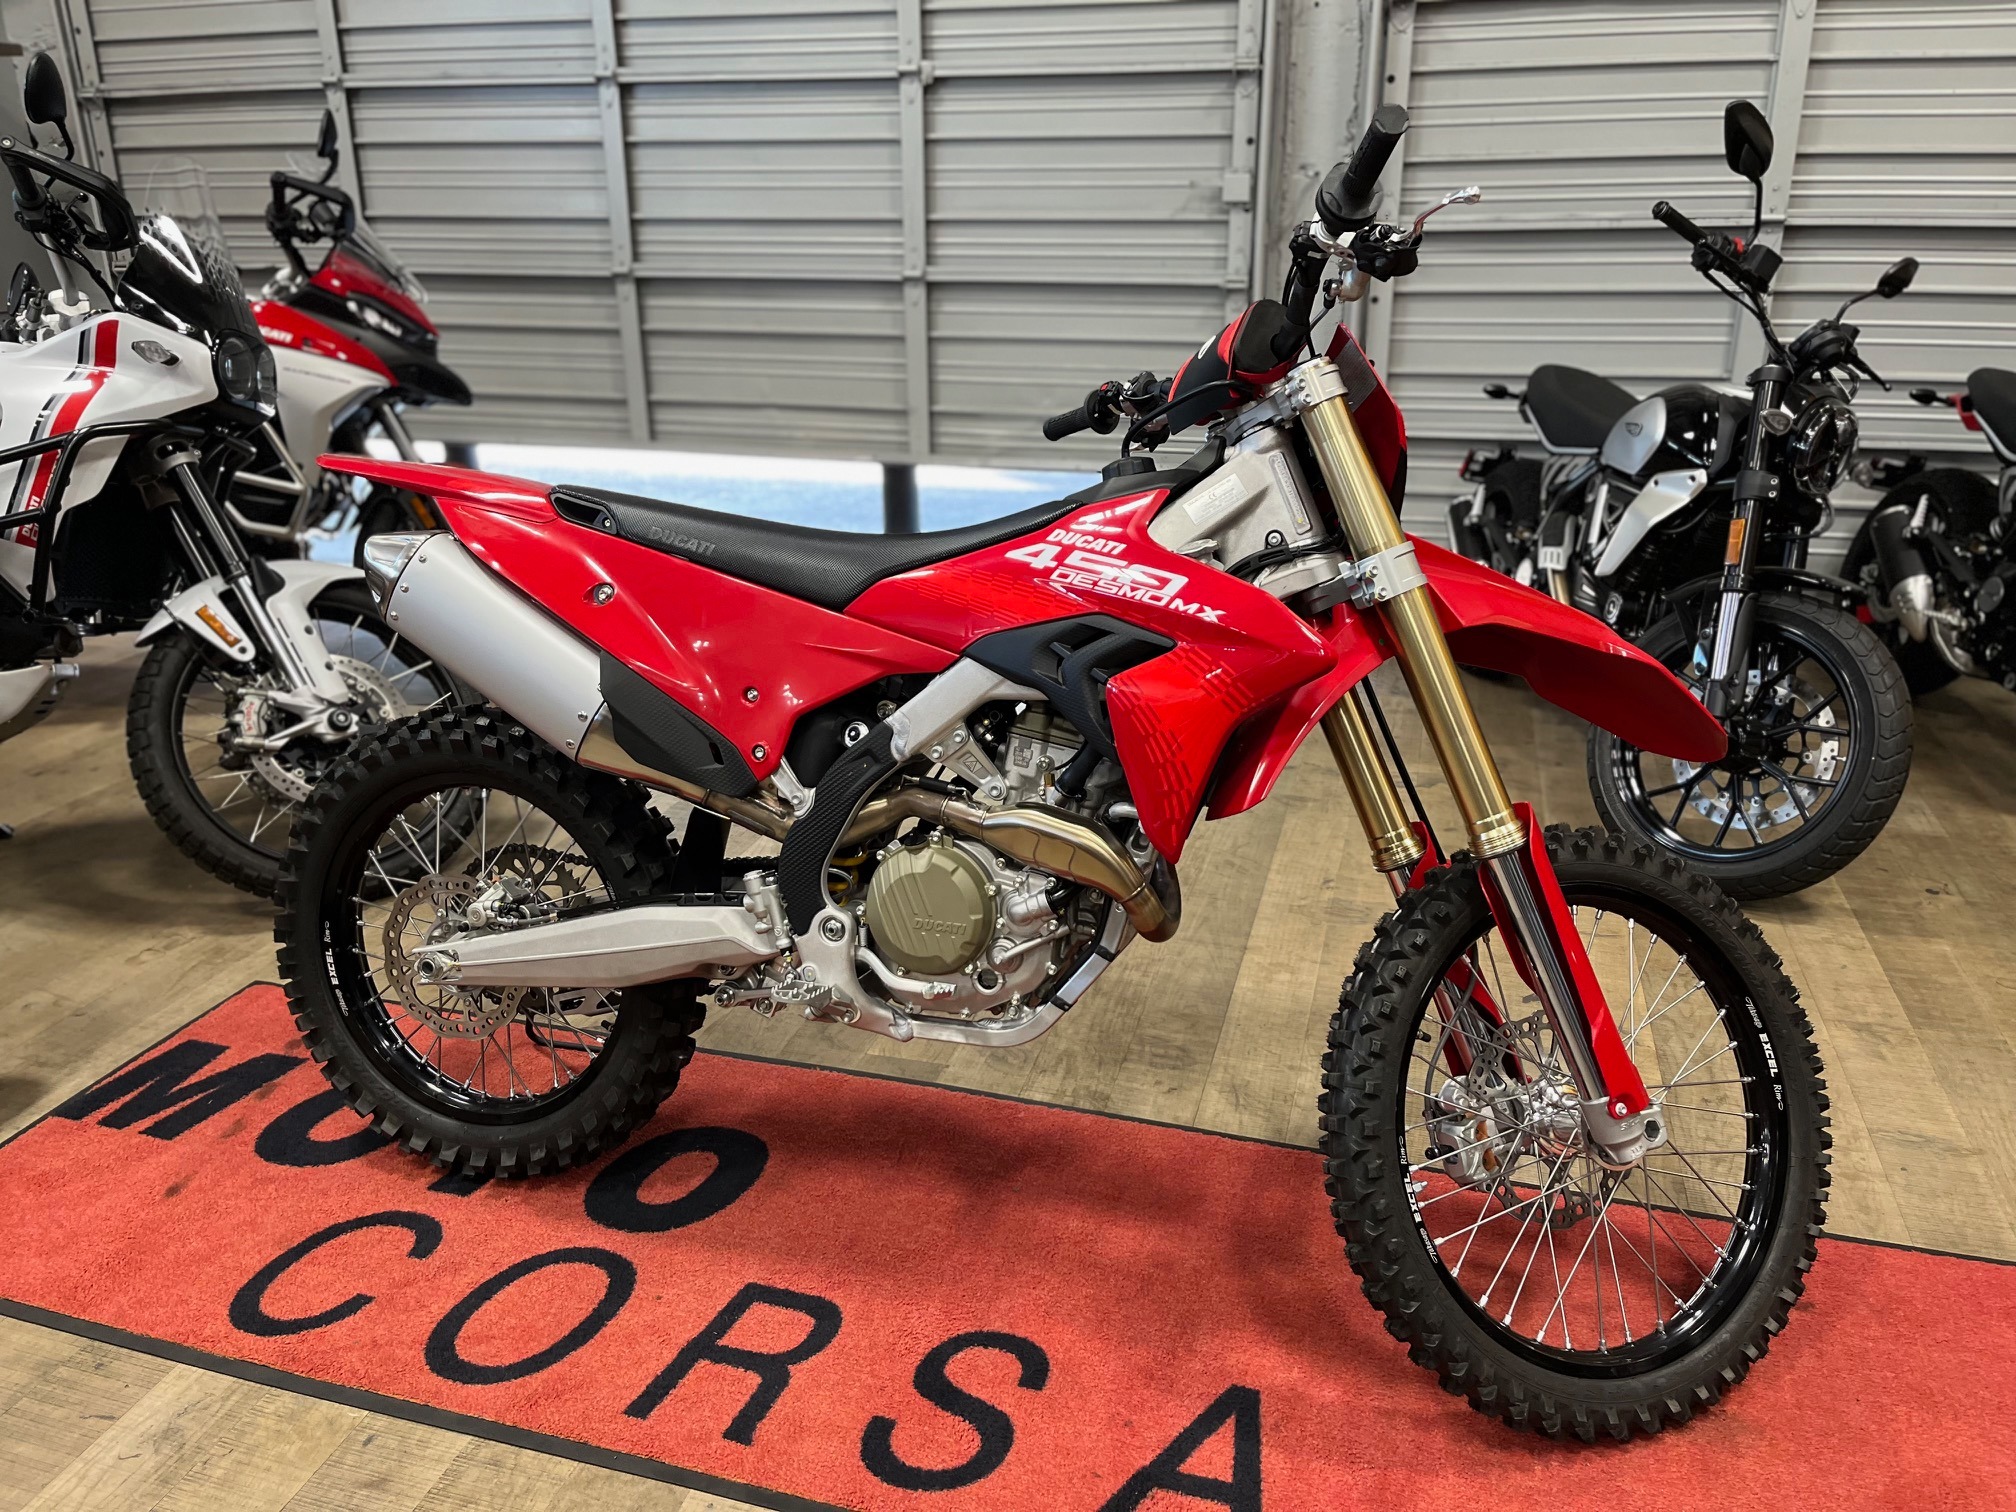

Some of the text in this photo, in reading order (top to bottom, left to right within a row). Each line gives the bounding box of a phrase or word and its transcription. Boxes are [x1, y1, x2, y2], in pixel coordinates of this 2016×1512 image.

[647, 526, 716, 556] DUCATI
[1046, 528, 1127, 555] DUCATI
[1005, 542, 1189, 598] 450
[1050, 567, 1228, 625] DESMO MX
[912, 917, 967, 936] DUCATI
[325, 948, 340, 986] EXCEL
[1758, 1032, 1779, 1078] EXCEL
[1773, 1084, 1784, 1111] Rim
[50, 1040, 769, 1233] MOO
[1404, 1172, 1422, 1223] EXCEL
[228, 1210, 1262, 1512] CORSA
